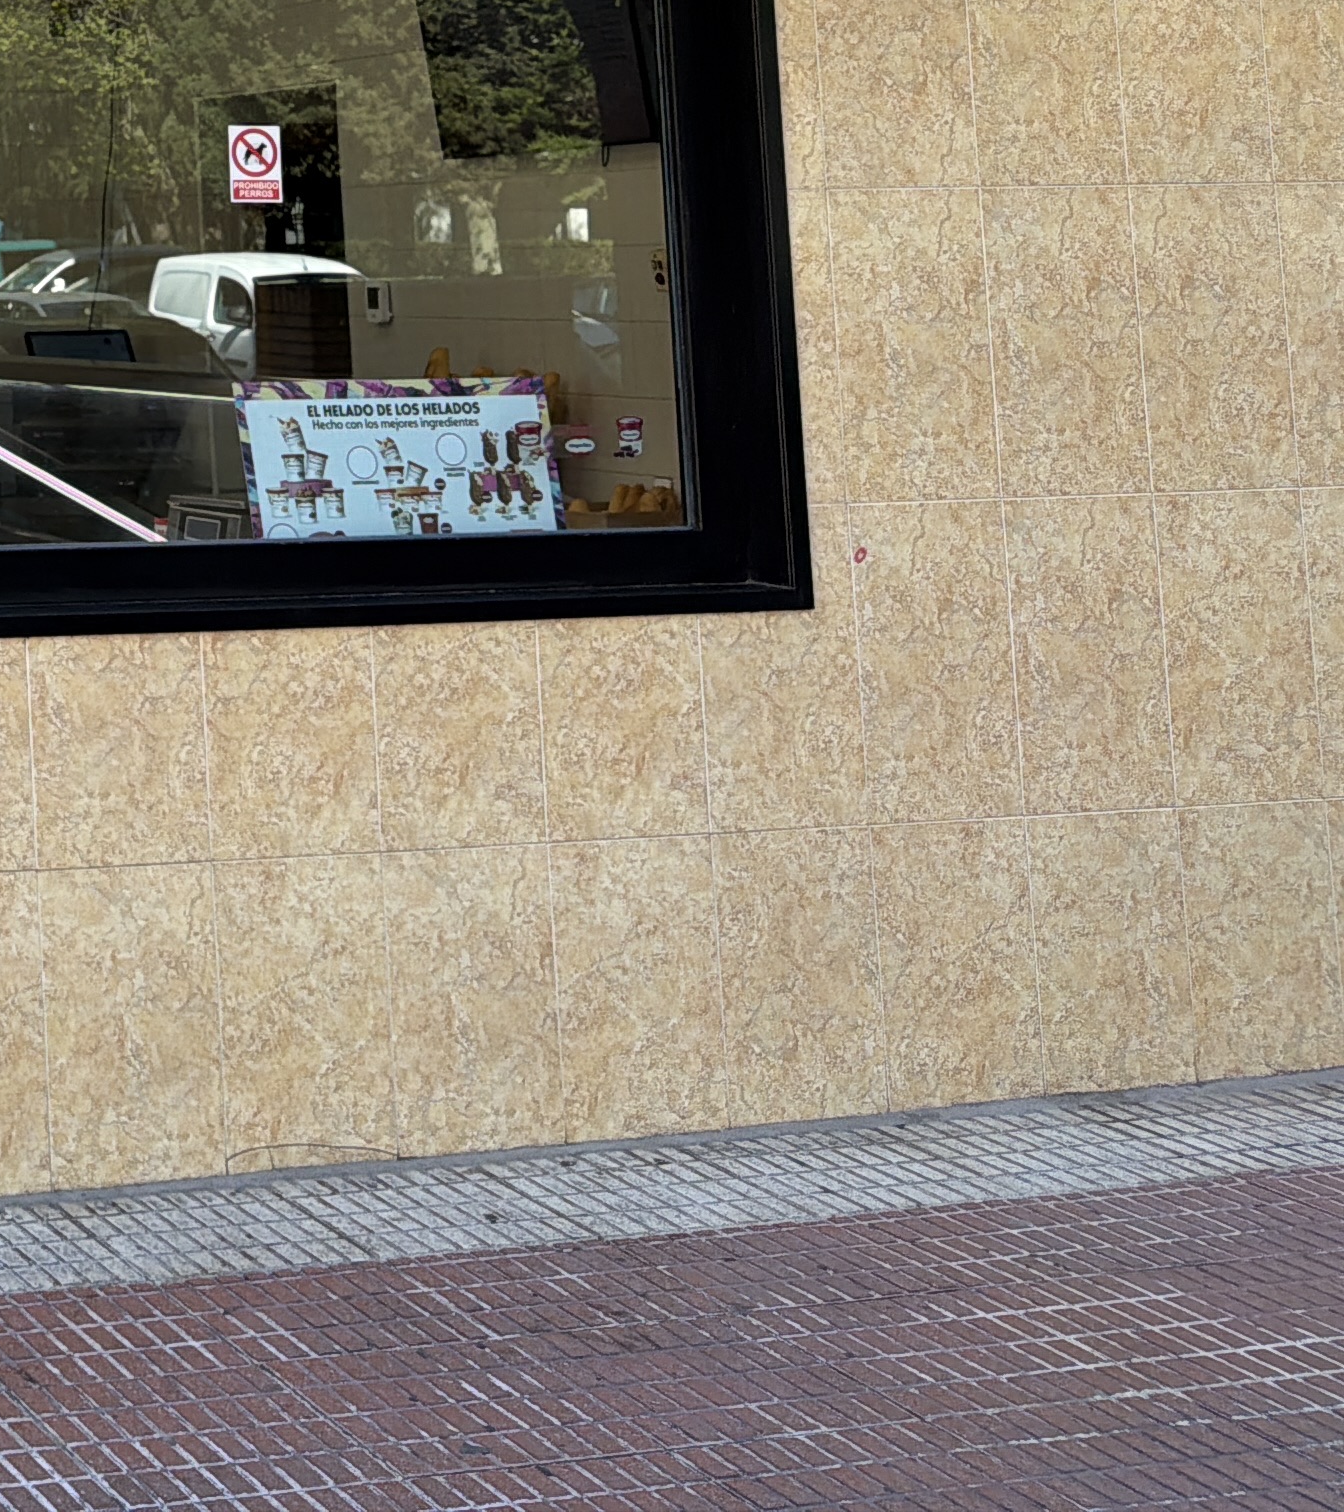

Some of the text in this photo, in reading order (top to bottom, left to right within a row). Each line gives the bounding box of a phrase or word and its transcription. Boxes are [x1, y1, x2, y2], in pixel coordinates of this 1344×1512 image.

[233, 181, 279, 189] PROHIBIDO
[307, 401, 480, 418] EL HELADO DE LOS HELADOS
[312, 417, 479, 431] Hecho con los mejores ingredientes
